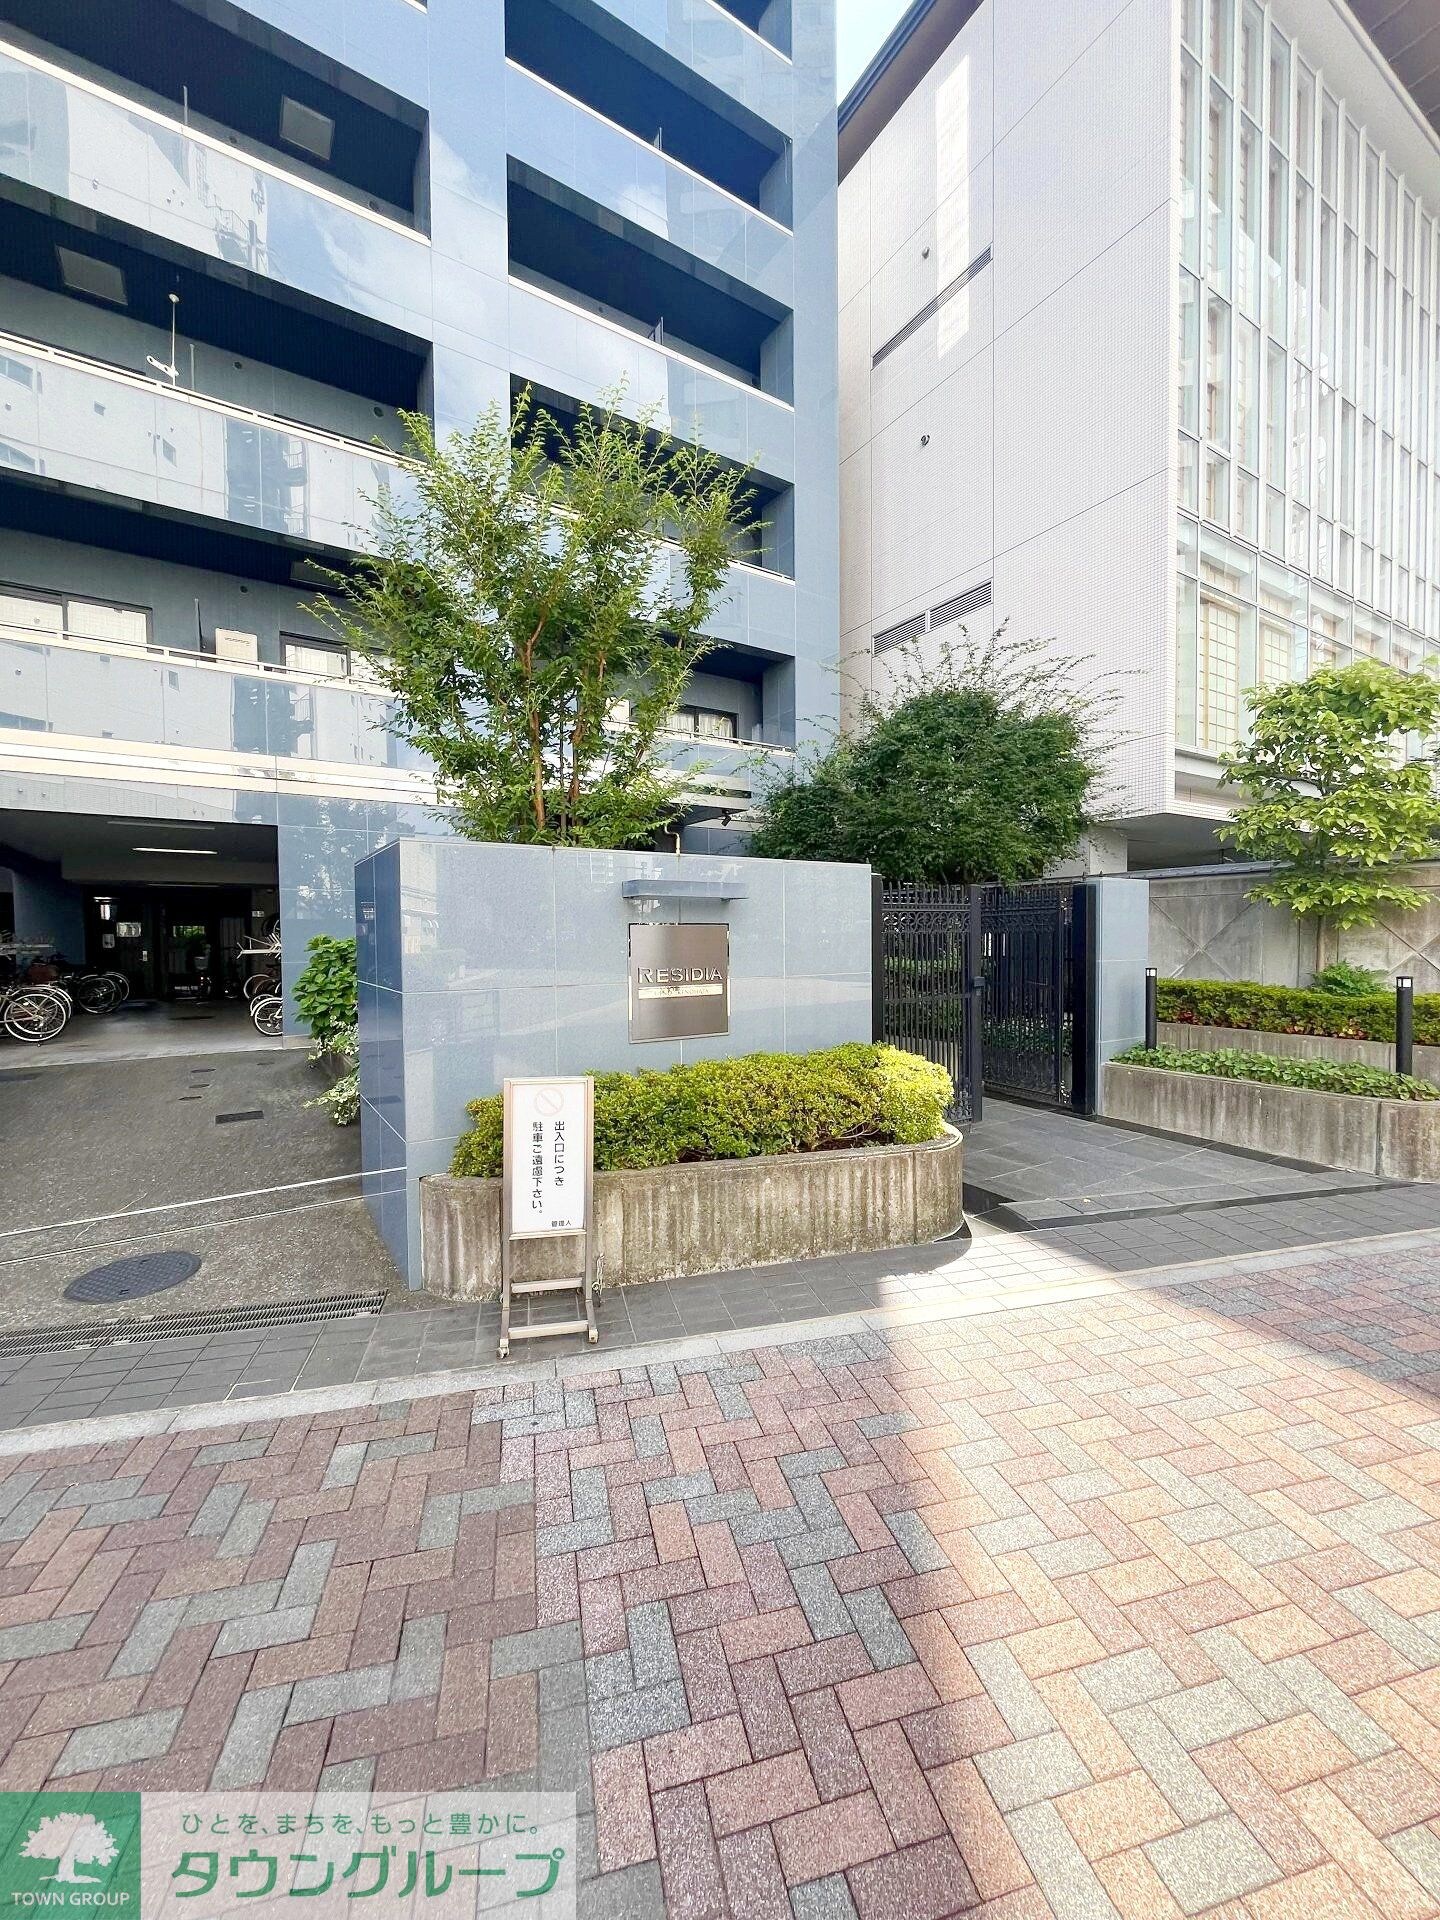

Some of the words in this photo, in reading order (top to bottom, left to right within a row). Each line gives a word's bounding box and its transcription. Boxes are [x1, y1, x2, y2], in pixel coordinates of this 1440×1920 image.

[637, 967, 723, 983] RESIDIA
[532, 1121, 543, 1214] 駐車ご遠慮下さい。
[554, 1120, 565, 1187] 出入口につき
